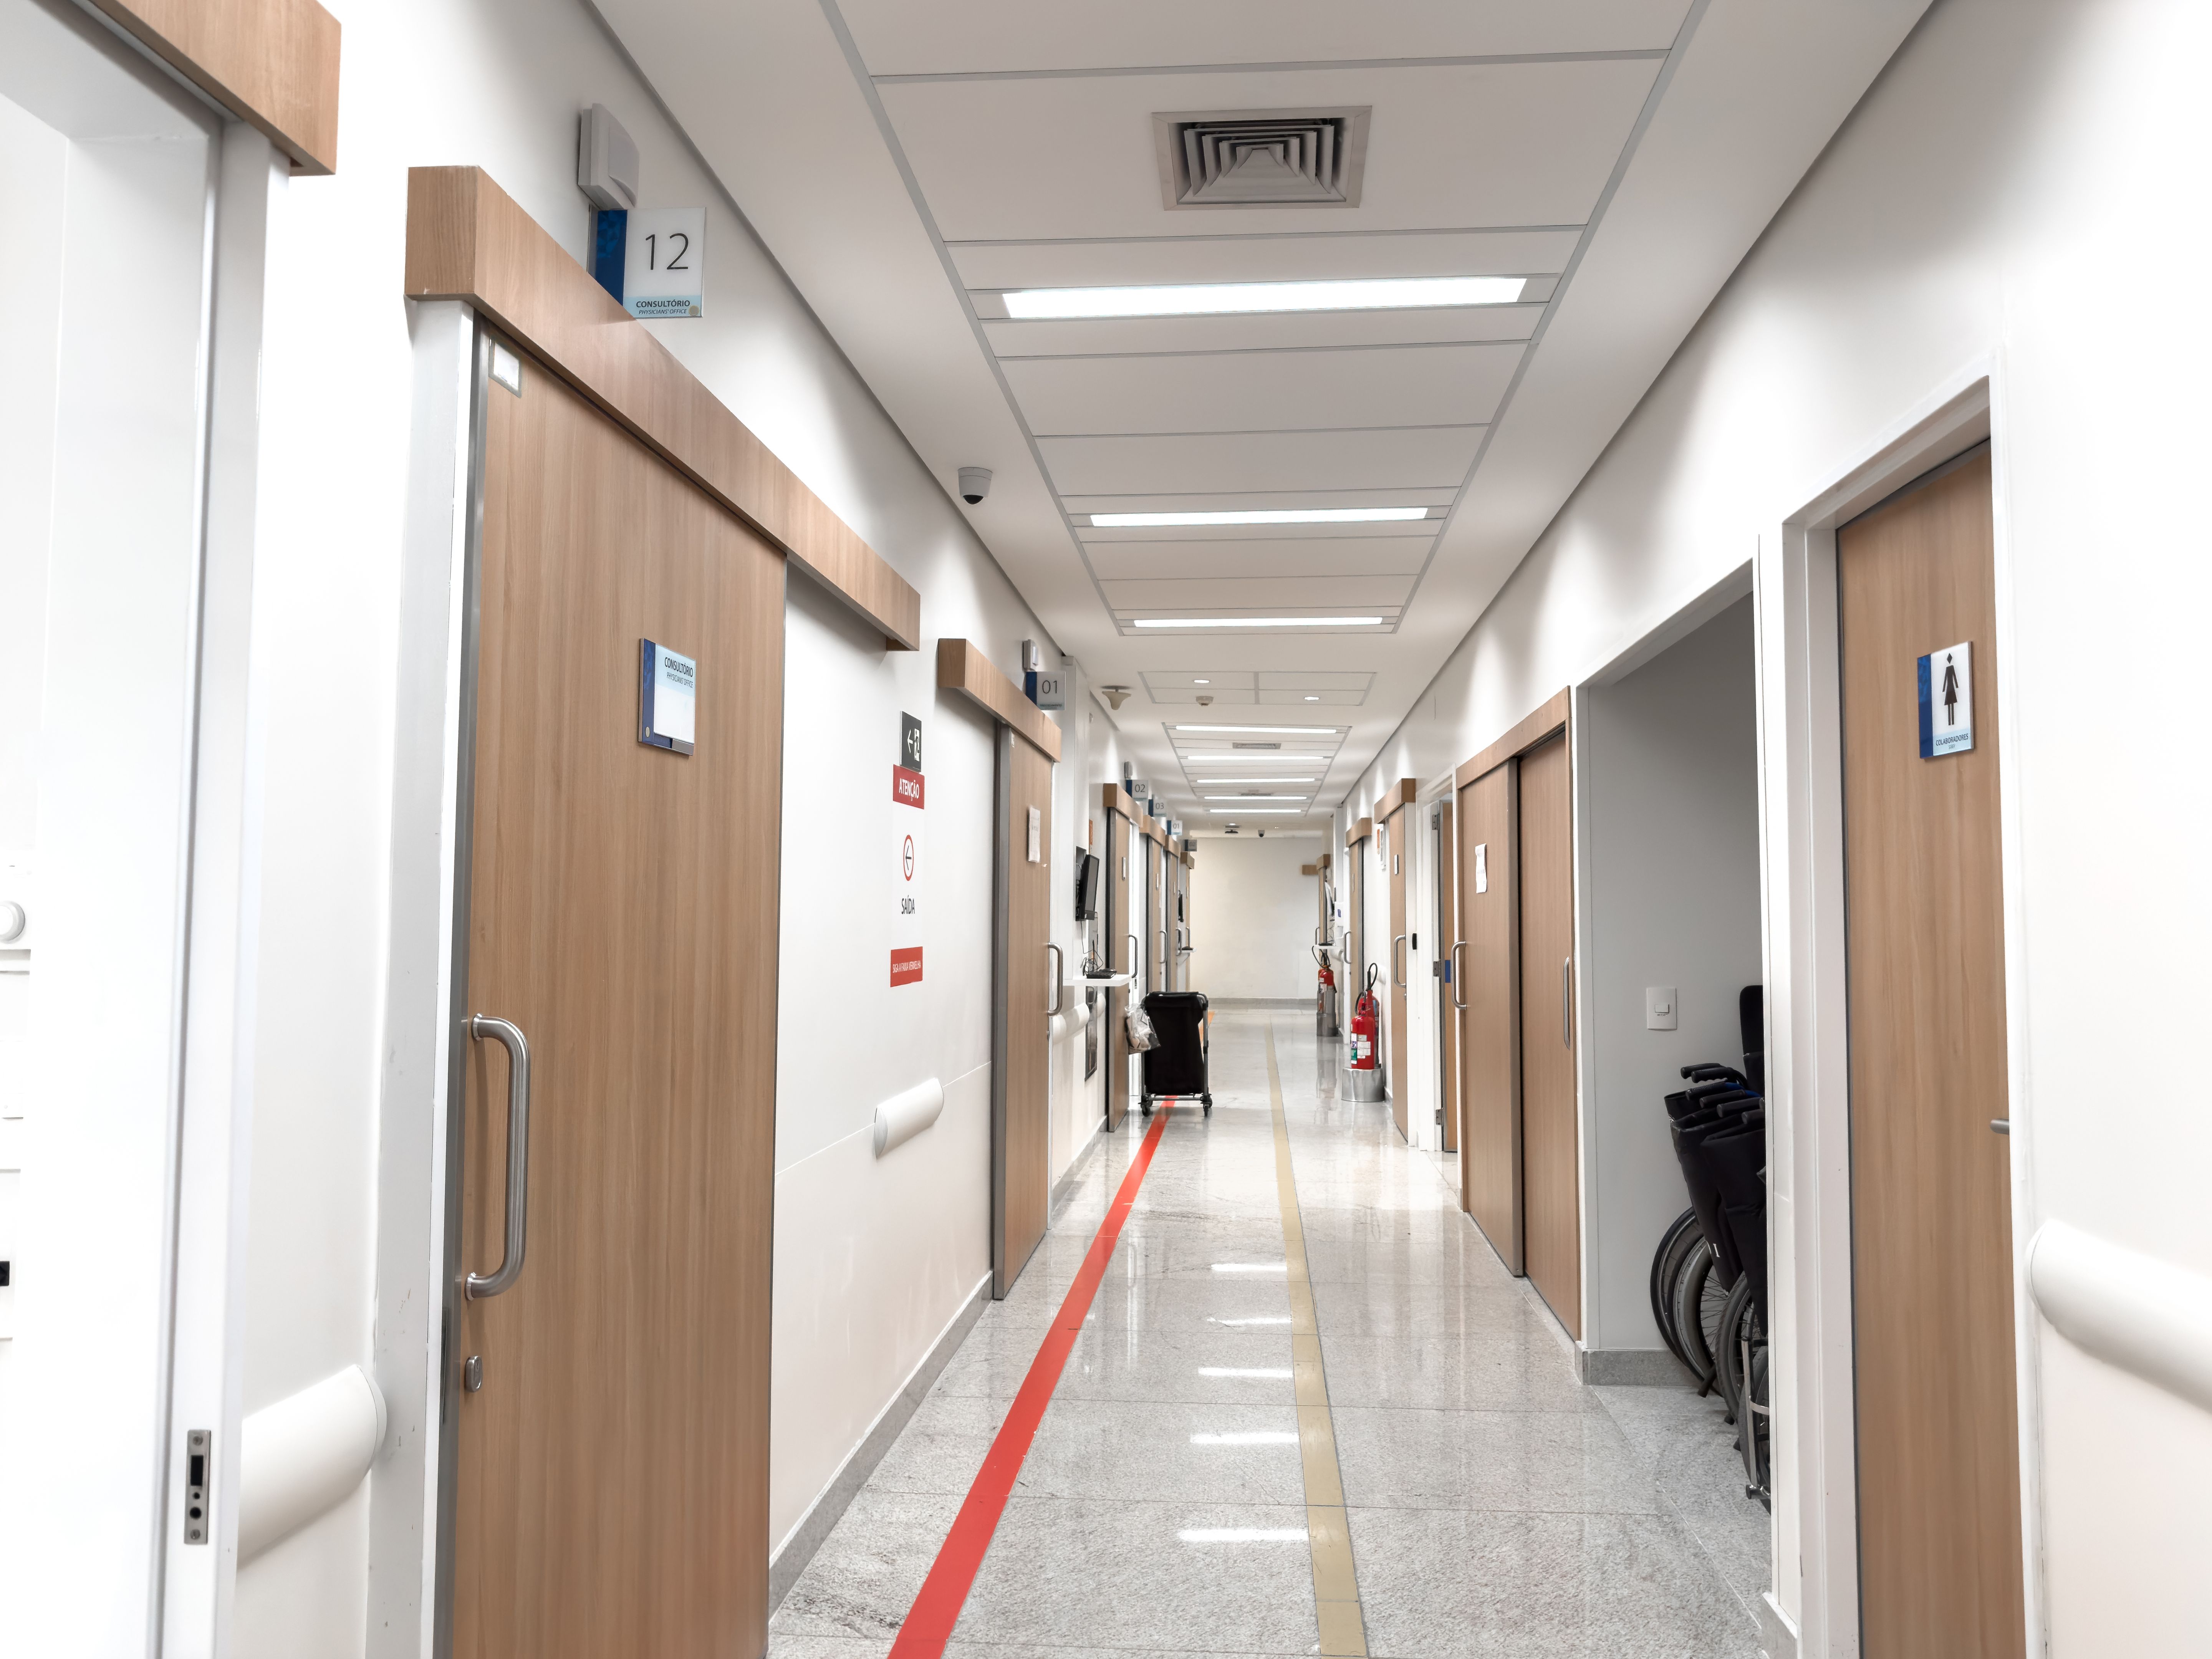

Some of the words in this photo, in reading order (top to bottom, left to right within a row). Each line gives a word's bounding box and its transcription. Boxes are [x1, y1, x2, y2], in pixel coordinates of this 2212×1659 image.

[645, 233, 689, 270] 12
[636, 299, 690, 308] CONSULTÓRIO
[664, 657, 693, 677] CONSULTÓRIO
[684, 678, 693, 689] OFFICE
[1042, 680, 1057, 694] 01
[1936, 733, 1969, 746] COLABORADORES
[899, 778, 919, 801] ATENÇÃO
[1135, 784, 1145, 792] 02
[901, 895, 915, 914] SAÍDA
[899, 963, 901, 972] A
[909, 960, 921, 971] VERMELHA
